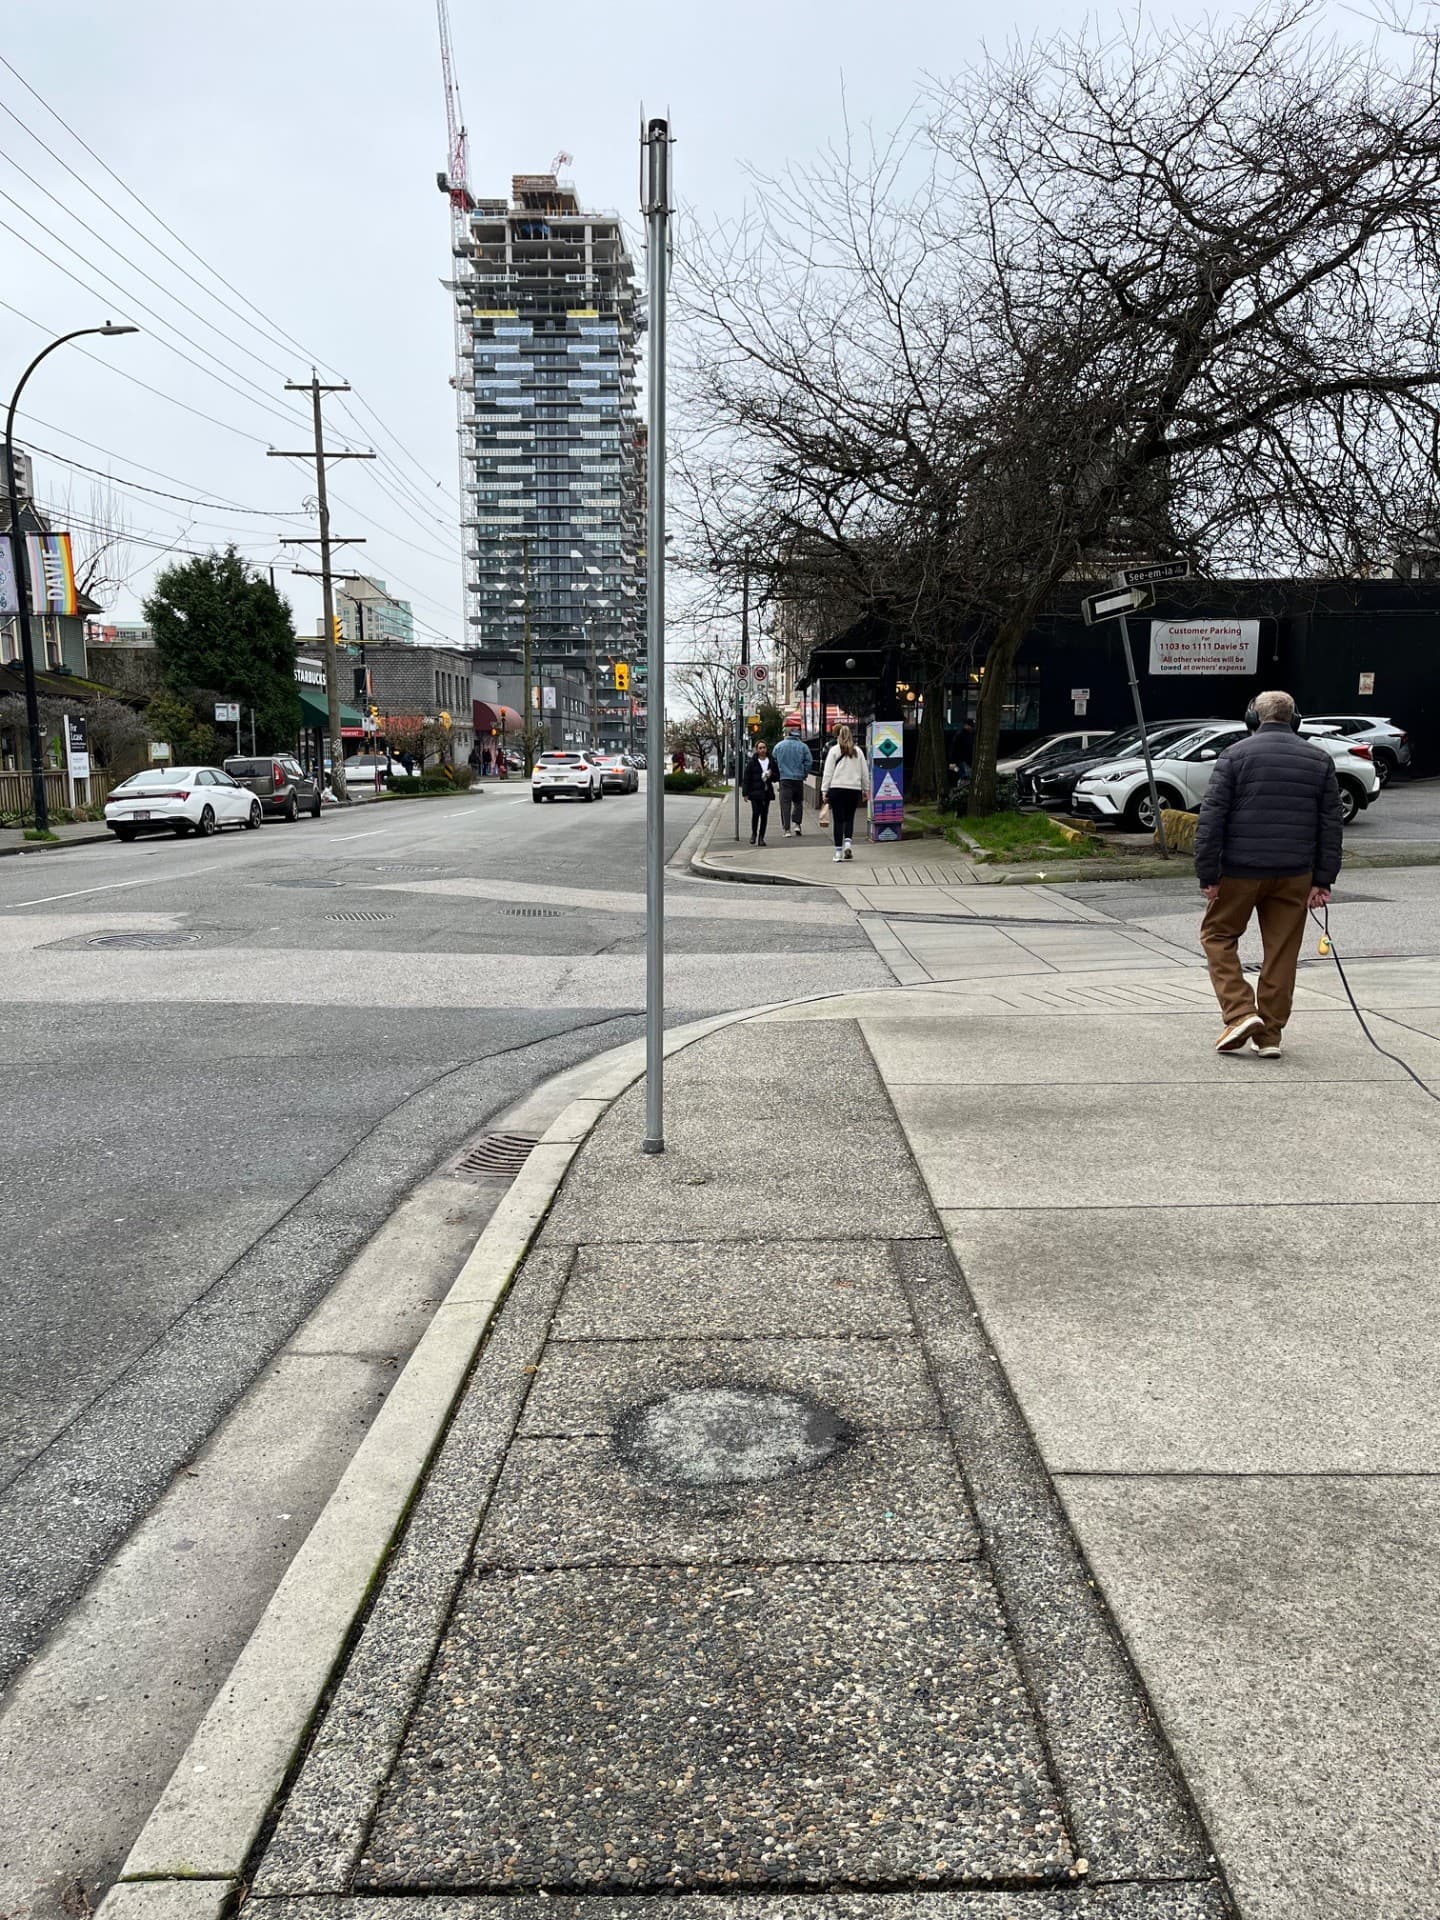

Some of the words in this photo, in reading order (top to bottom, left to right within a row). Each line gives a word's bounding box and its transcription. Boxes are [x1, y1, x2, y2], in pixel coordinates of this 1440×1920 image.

[42, 549, 65, 601] DAVIE
[1168, 627, 1208, 635] Customer
[1209, 627, 1242, 636] Parking
[1160, 643, 1180, 651] 1103
[1192, 643, 1212, 651] 1111
[1239, 643, 1250, 651] ST
[294, 669, 327, 686] STARBUCKS
